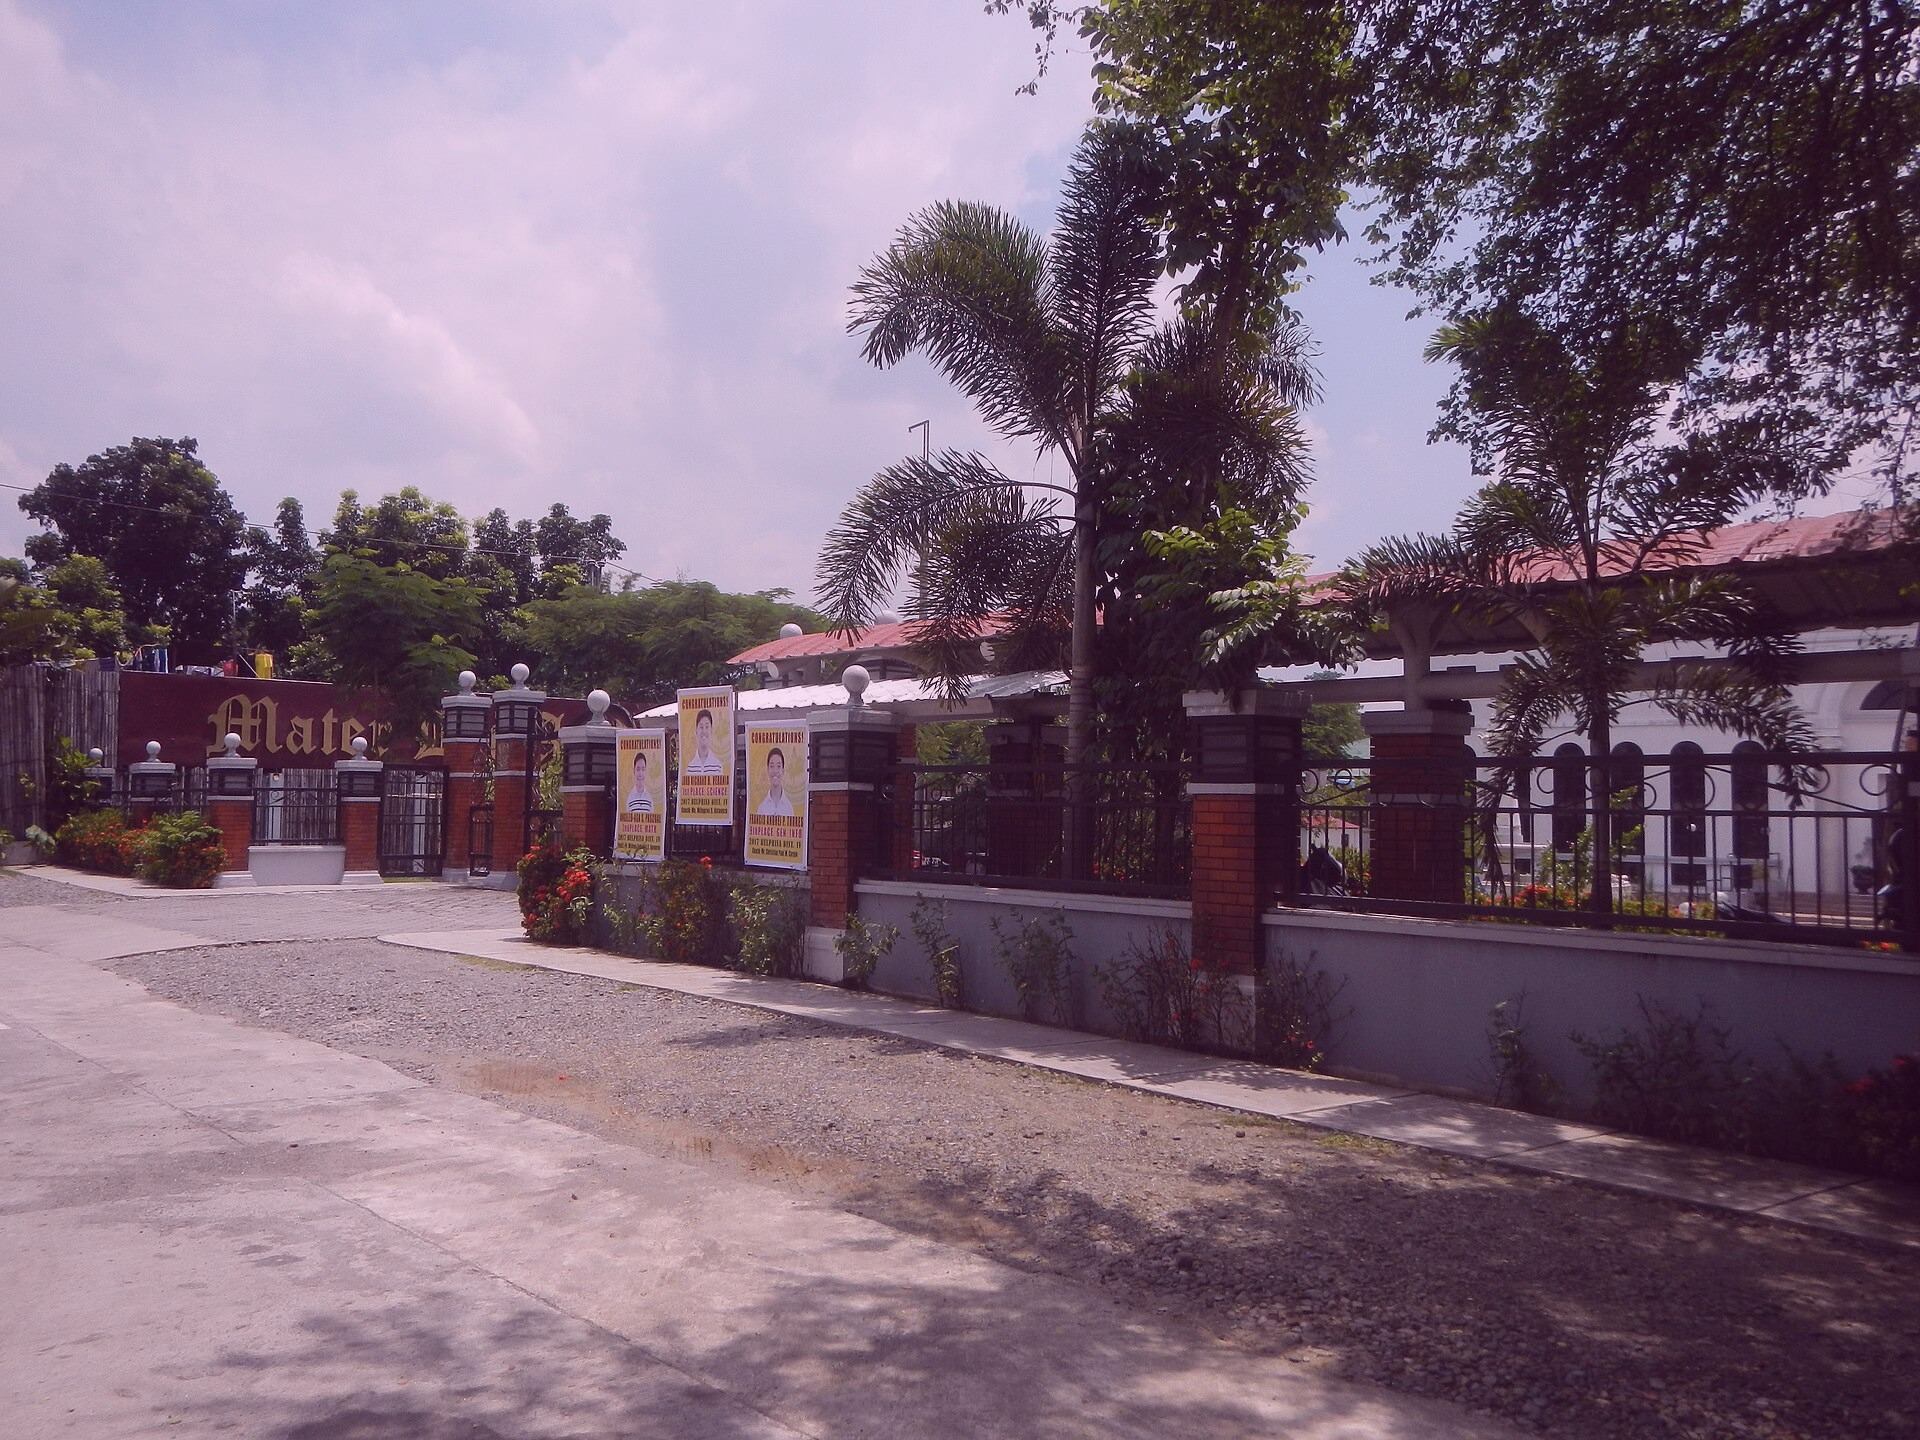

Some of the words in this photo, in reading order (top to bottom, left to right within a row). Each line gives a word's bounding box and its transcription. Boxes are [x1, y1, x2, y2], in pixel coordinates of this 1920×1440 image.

[682, 696, 729, 710] CONGRATULATIONS!
[206, 693, 392, 757] Mater
[751, 731, 804, 744] CONGRATULATIONS!
[620, 739, 662, 750] CONGRATULATIONS!
[707, 787, 727, 796] SCIENCE
[787, 816, 803, 827] TORRES
